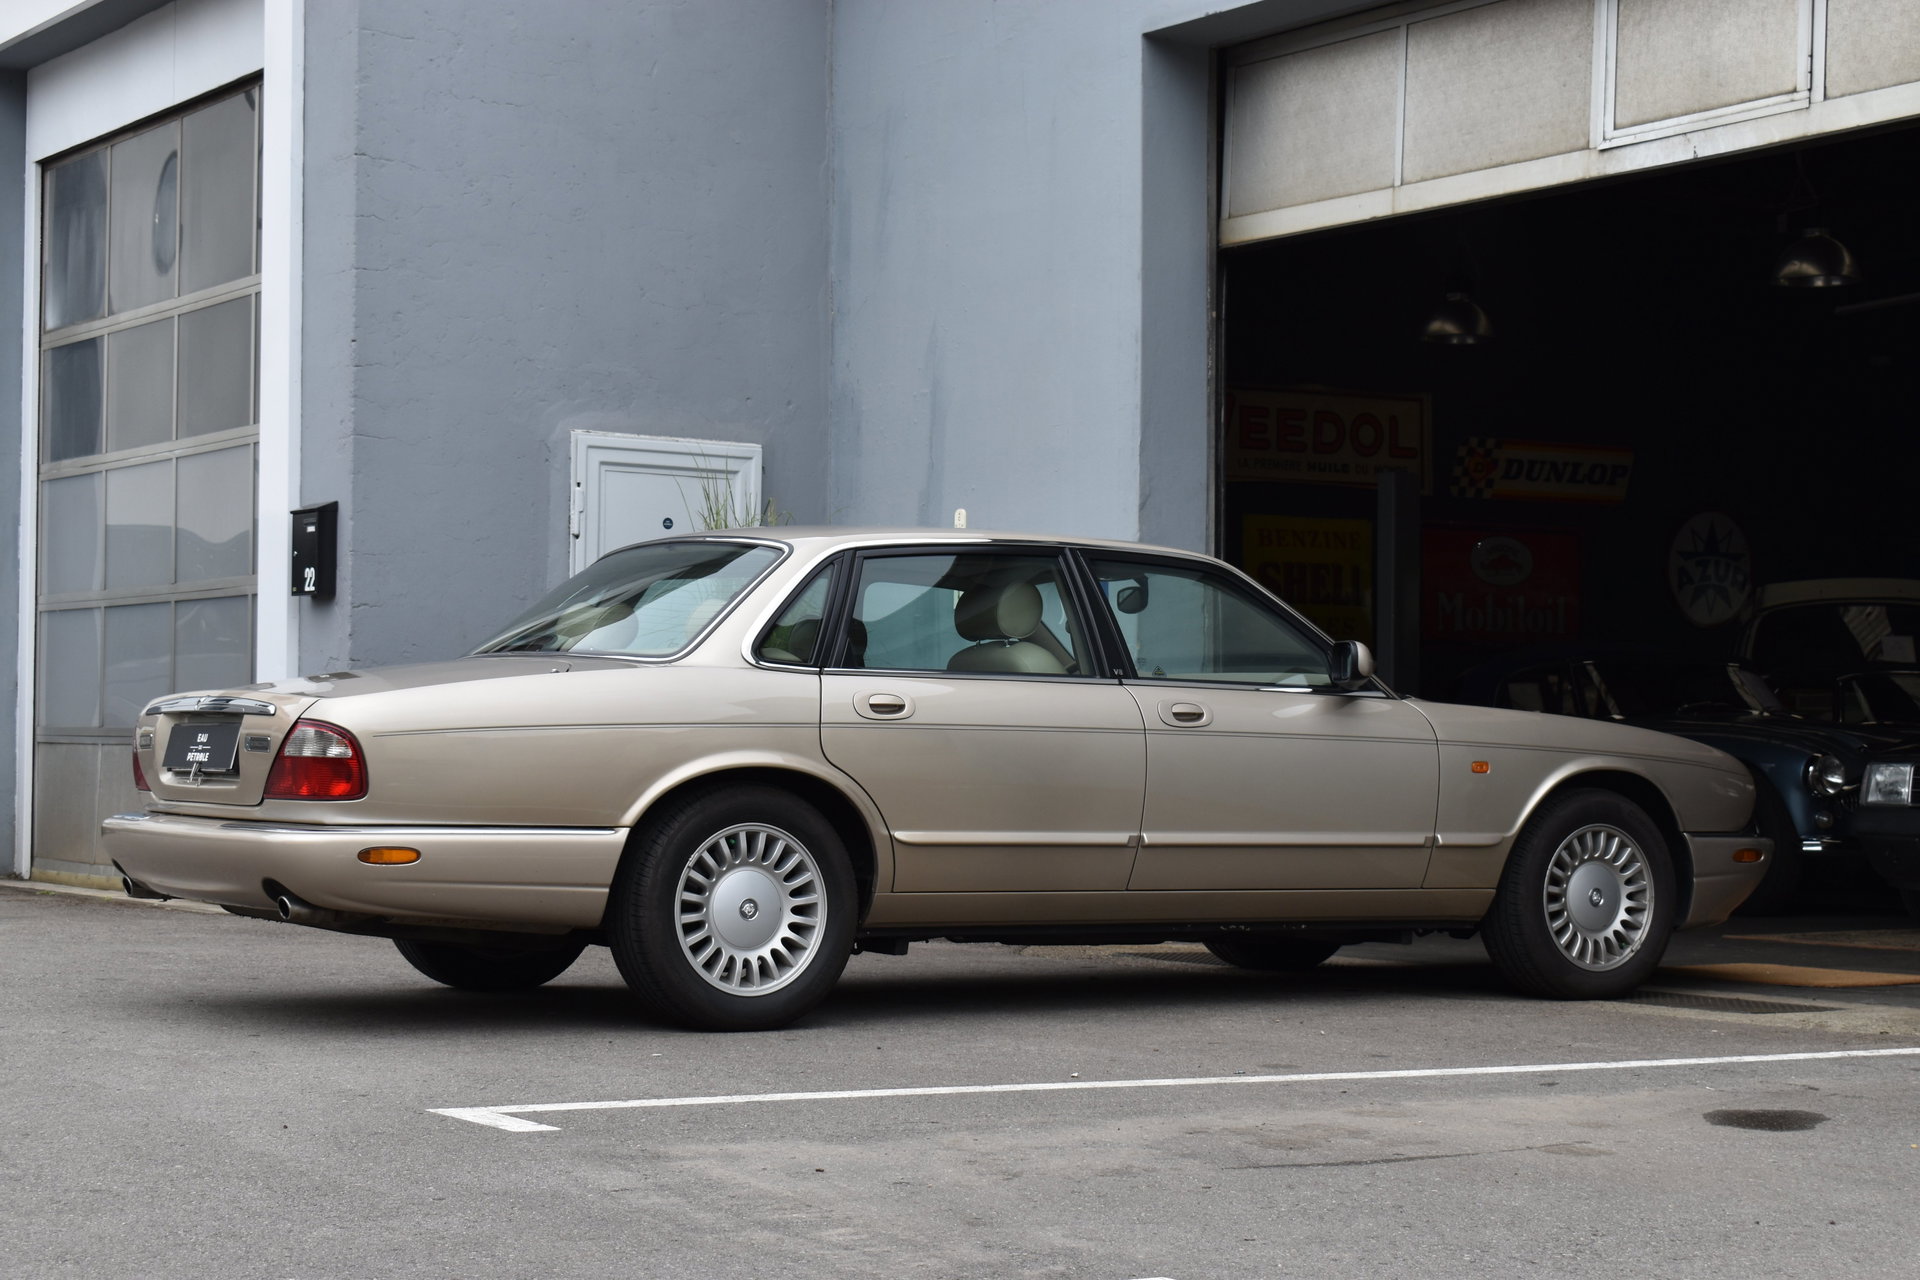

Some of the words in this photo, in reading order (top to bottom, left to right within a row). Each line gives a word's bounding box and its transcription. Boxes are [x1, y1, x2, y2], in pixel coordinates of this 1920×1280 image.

[1307, 461, 1350, 474] HUILE
[1355, 464, 1369, 475] DU
[1500, 457, 1629, 485] DUNLOP
[1256, 527, 1361, 551] BENZINE
[303, 566, 316, 592] 22
[1257, 561, 1361, 606] SHELL
[1678, 559, 1749, 593] AZUR
[1437, 591, 1569, 634] Mobiloil
[197, 733, 209, 743] EAU
